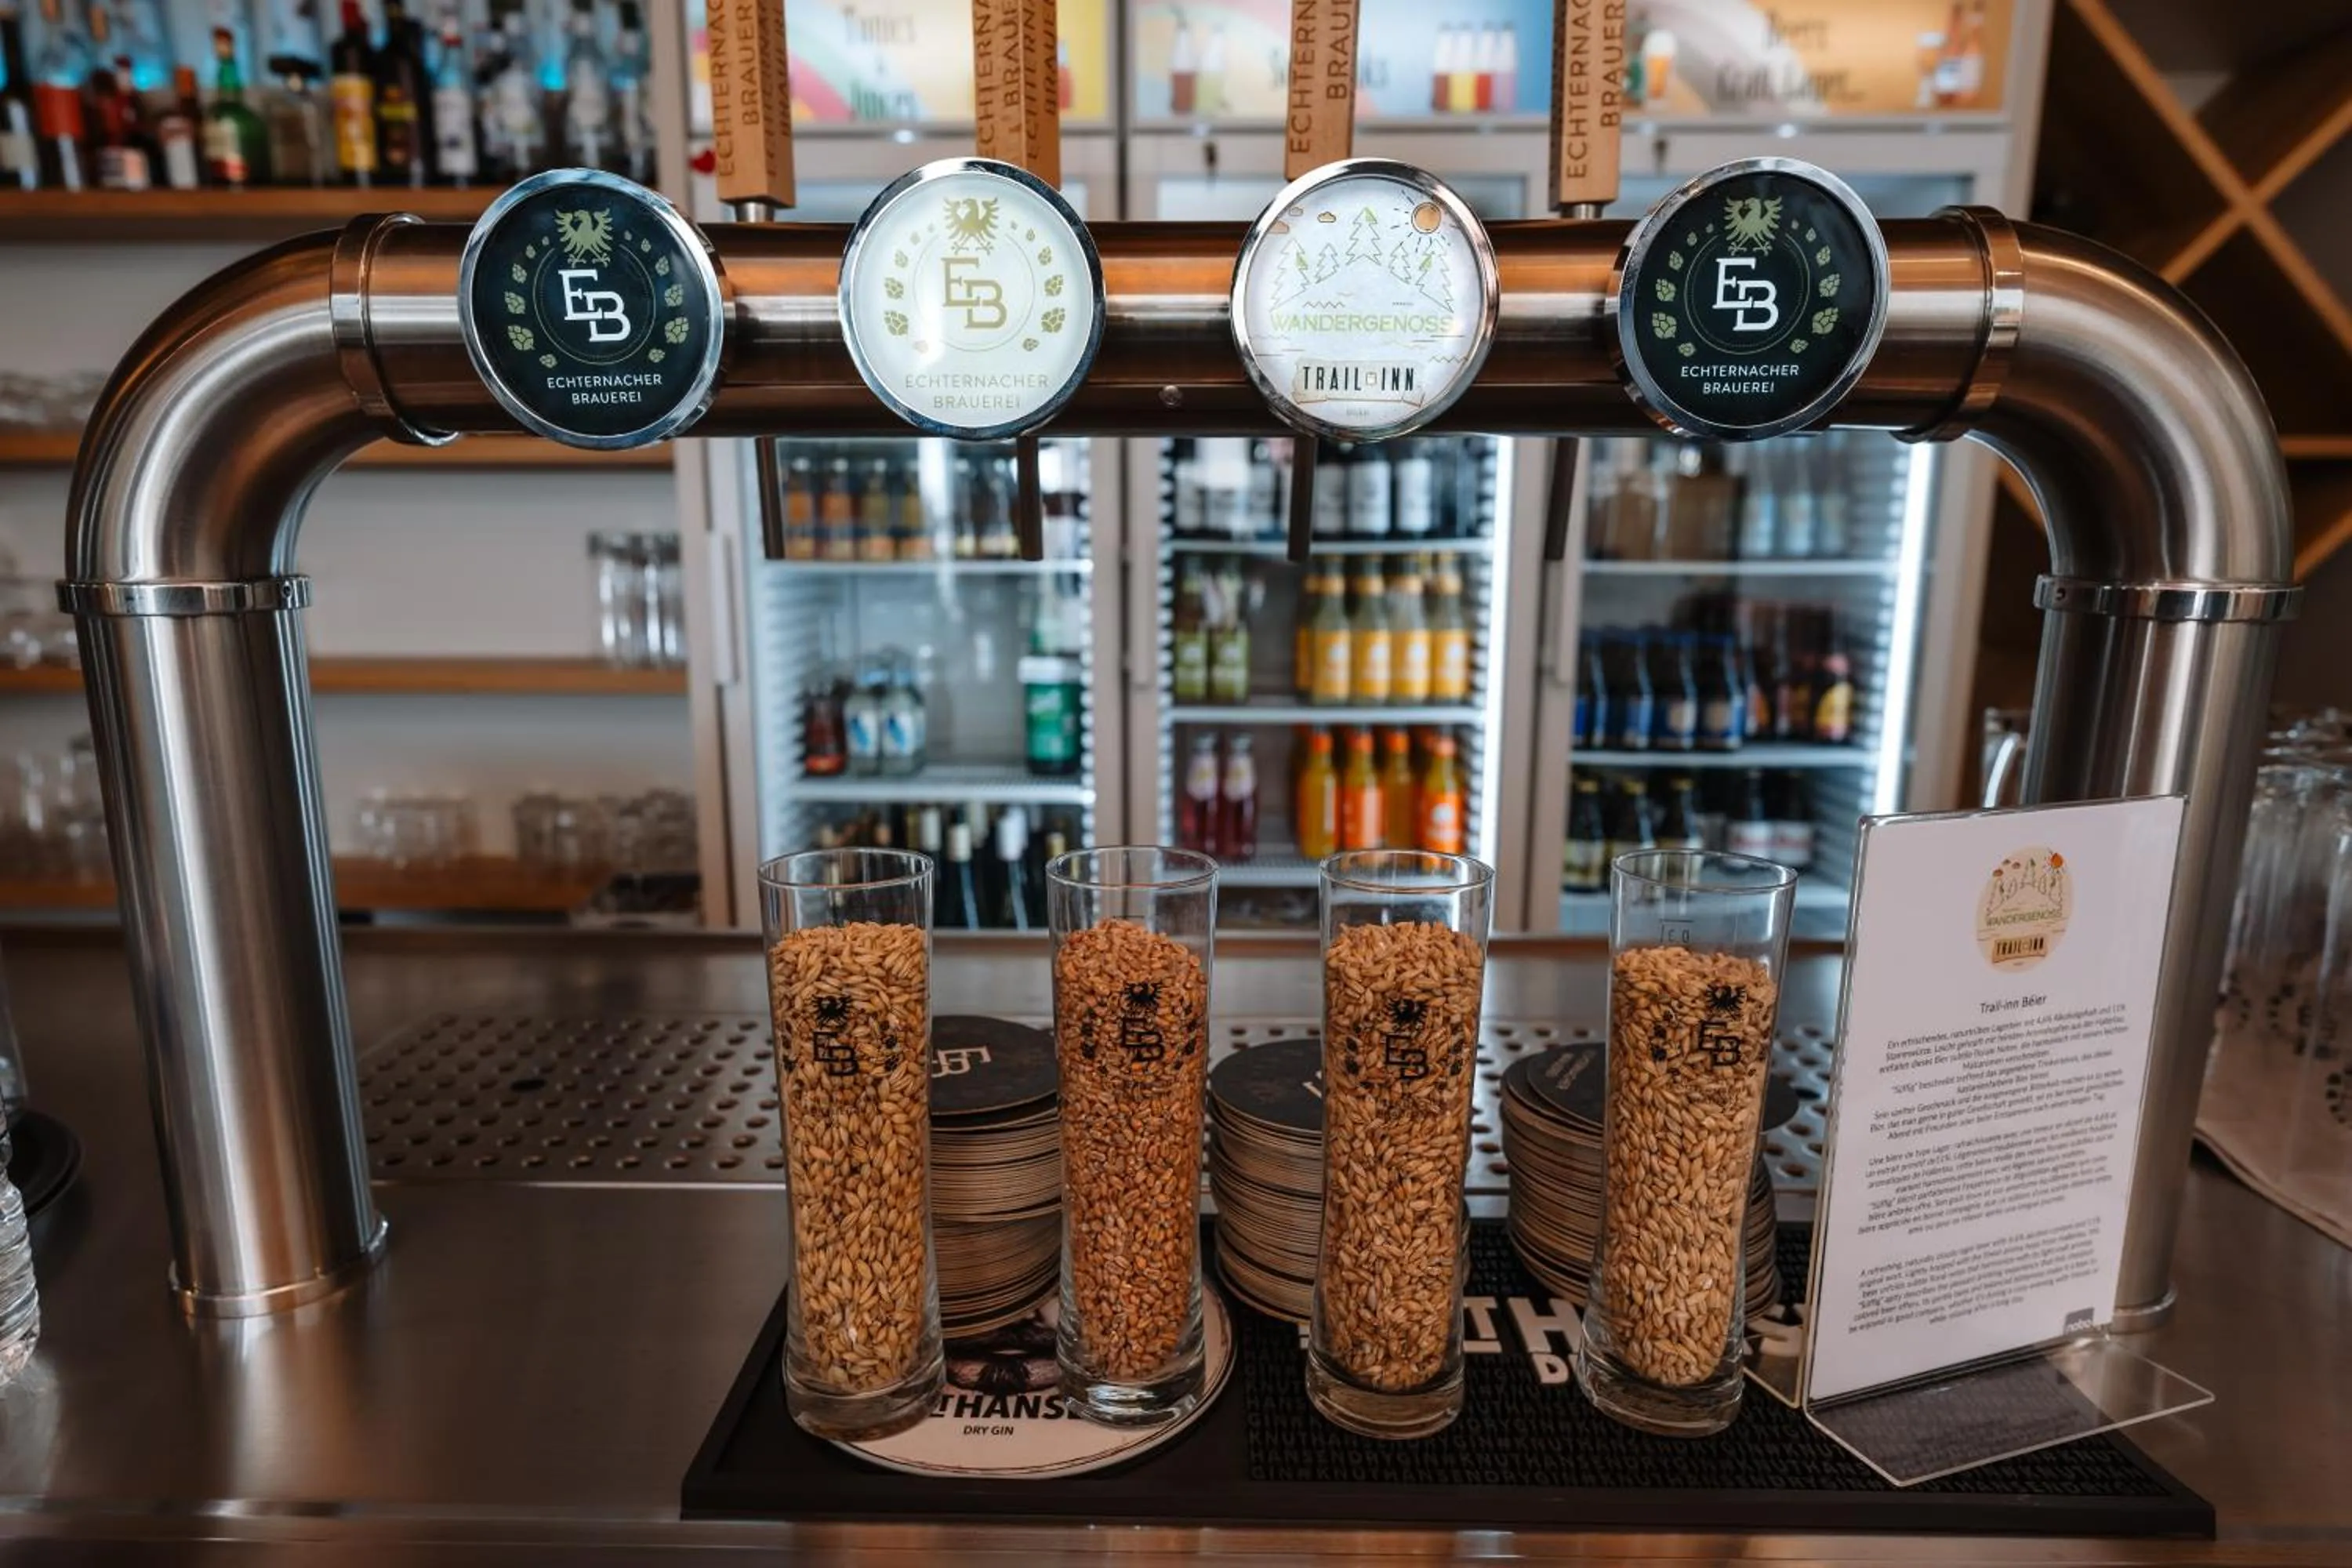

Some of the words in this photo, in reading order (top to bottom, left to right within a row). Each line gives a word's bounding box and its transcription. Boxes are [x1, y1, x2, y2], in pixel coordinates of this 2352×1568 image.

[940, 256, 1007, 330] EB
[1711, 257, 1780, 332] EB
[558, 269, 631, 343] EB
[1302, 365, 1363, 392] TRAIL
[1381, 367, 1415, 392] INN
[1680, 365, 1800, 378] ECHTERNACHER
[546, 373, 663, 390] ECHTERNACHER
[905, 374, 1049, 390] ECHTERNACHER
[1702, 382, 1775, 394] BRAUEREI
[572, 391, 643, 405] BRAUEREI
[933, 395, 1022, 409] BRAUEREI
[964, 1425, 989, 1436] DRY
[990, 1425, 1014, 1436] GIN
